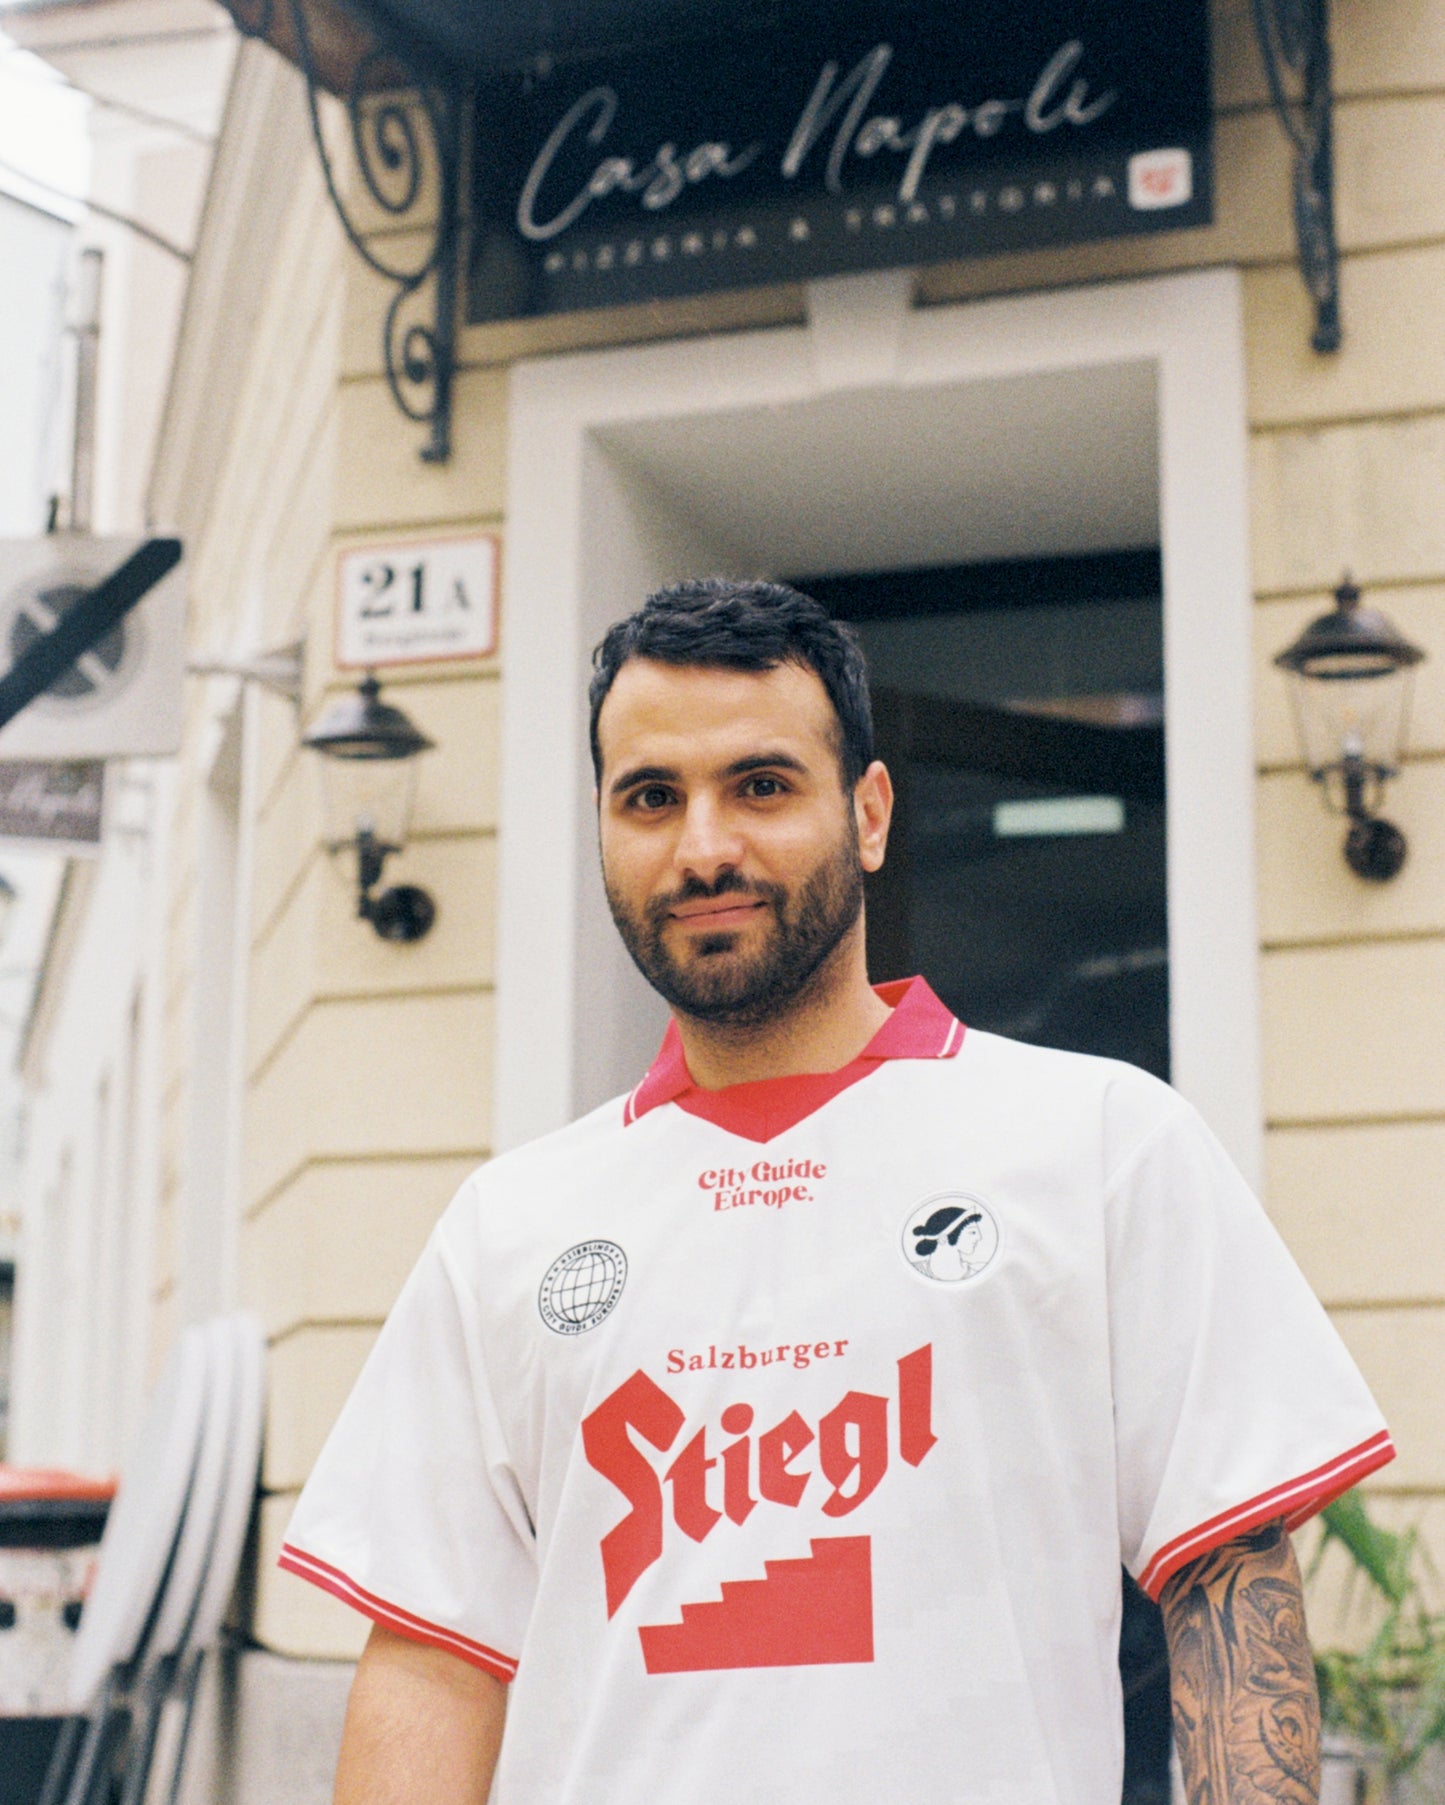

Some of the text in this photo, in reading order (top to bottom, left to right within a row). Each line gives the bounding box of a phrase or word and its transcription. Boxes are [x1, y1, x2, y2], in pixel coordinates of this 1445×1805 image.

[517, 41, 1118, 240] Casa Napoli
[698, 1158, 827, 1192] City Guide
[714, 1185, 814, 1211] Europe.
[667, 1339, 849, 1374] Salzburger
[581, 1343, 939, 1622] Stiegl
